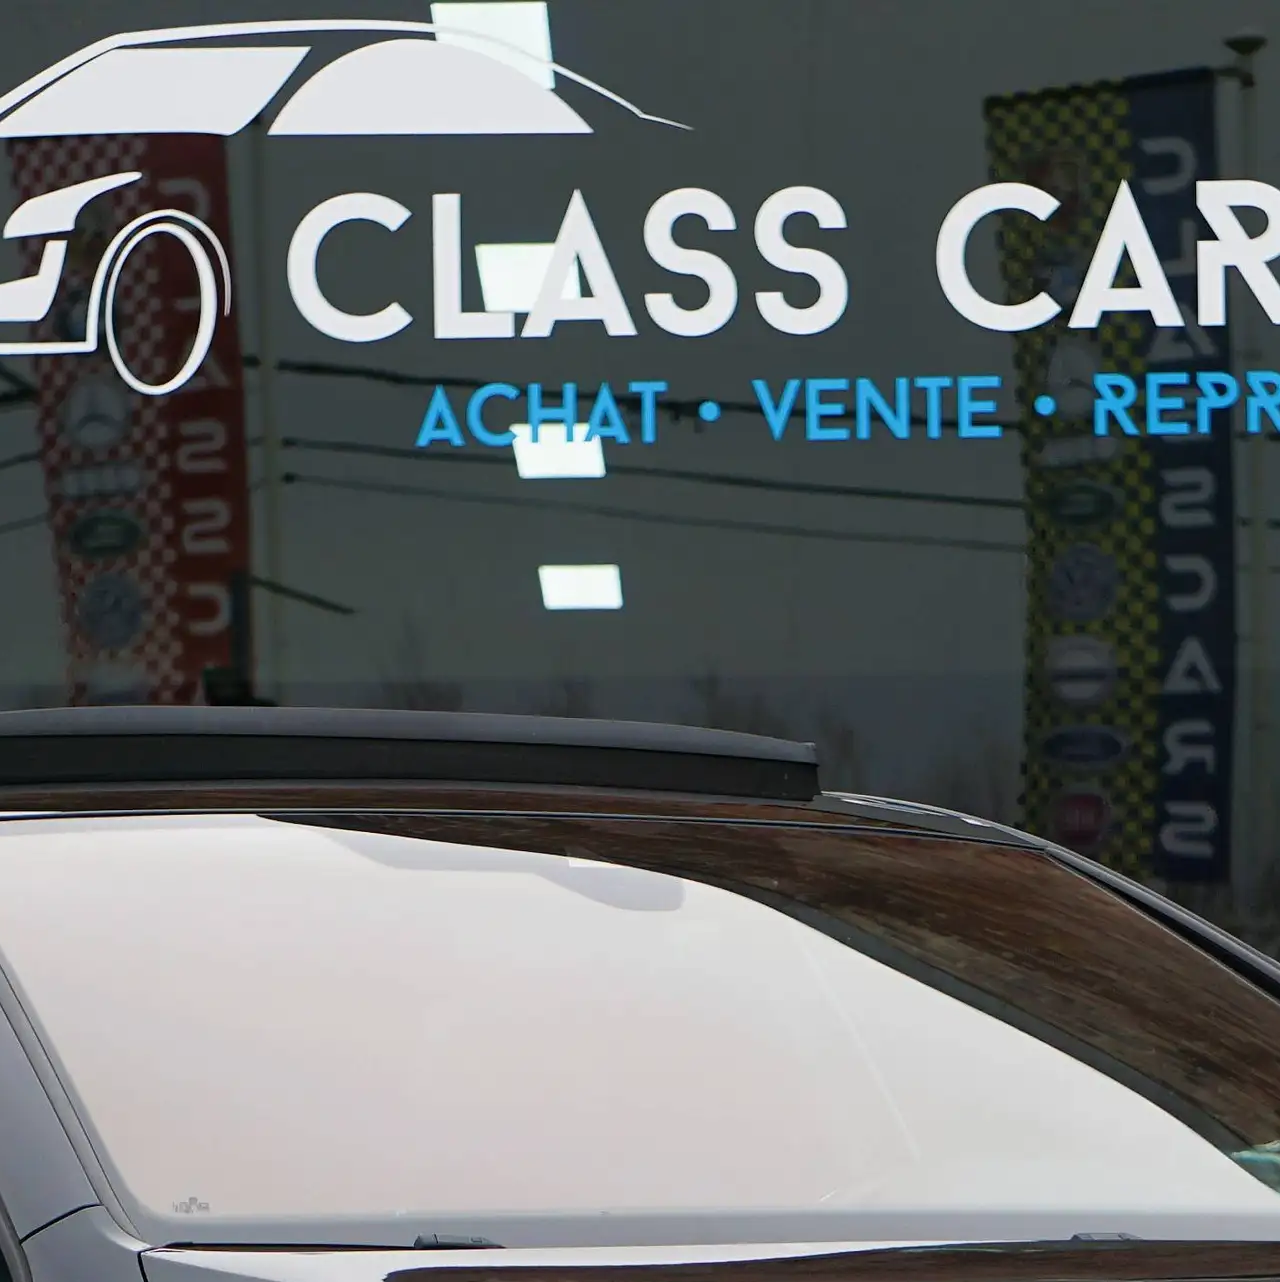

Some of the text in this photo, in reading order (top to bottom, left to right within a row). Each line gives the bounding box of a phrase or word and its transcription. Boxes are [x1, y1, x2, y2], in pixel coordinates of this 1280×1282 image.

[287, 186, 848, 343] CLASS
[415, 381, 668, 447] ACHAT
[752, 376, 1002, 441] VENTE
